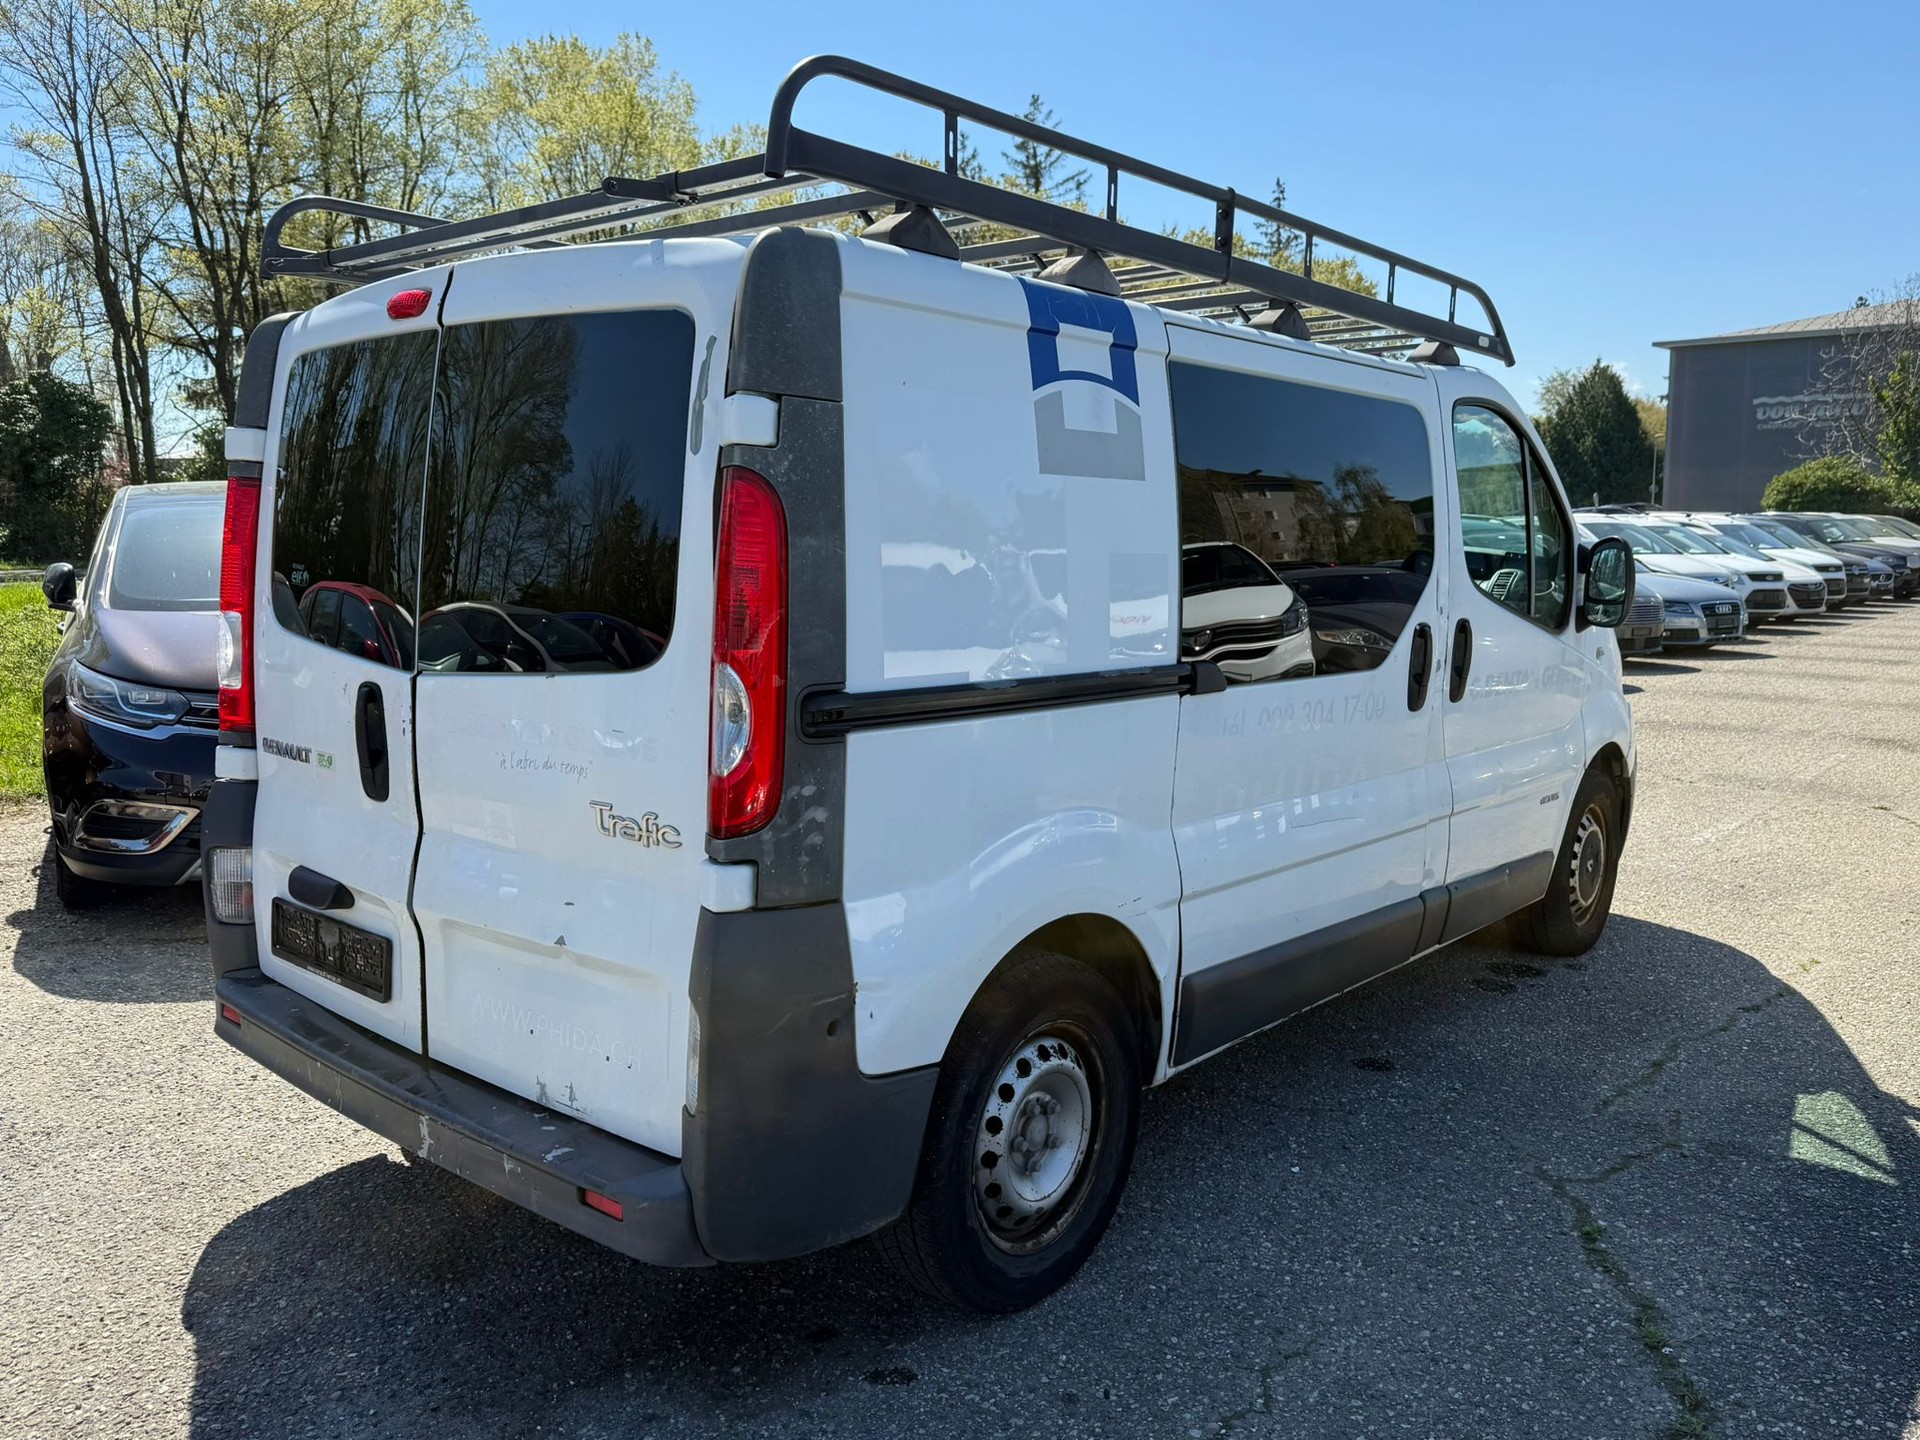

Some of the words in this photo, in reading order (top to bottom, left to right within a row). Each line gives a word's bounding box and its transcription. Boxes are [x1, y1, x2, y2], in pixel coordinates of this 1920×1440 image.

[1301, 697, 1335, 731] 304
[262, 737, 312, 764] RENAULT
[541, 755, 557, 771] du
[589, 799, 683, 849] Trafic
